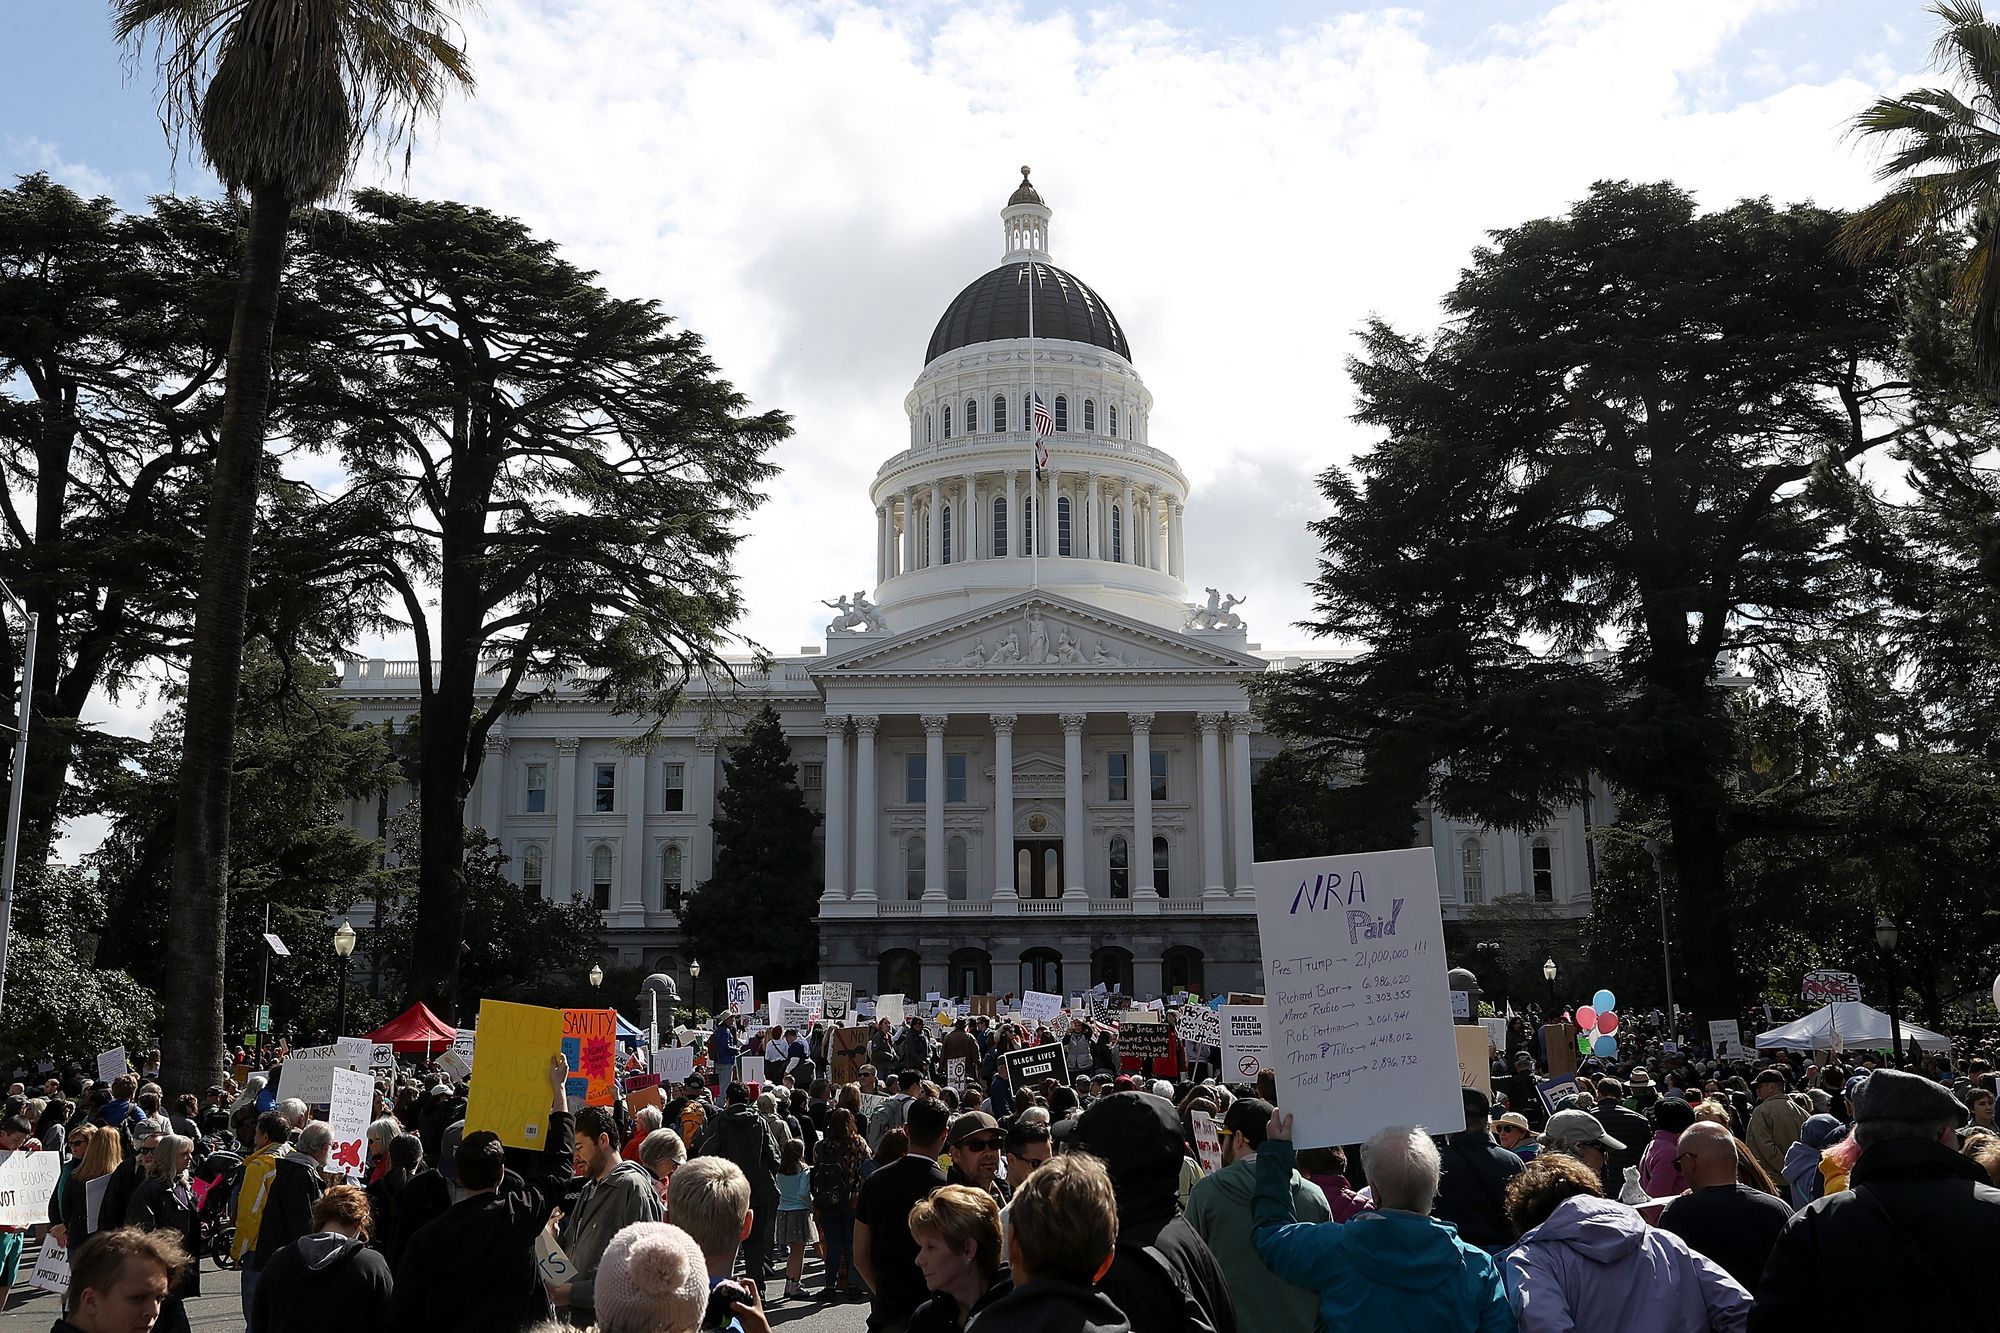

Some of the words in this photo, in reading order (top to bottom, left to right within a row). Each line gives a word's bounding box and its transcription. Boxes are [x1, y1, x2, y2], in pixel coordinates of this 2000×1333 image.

[1289, 870, 1366, 915] NRA
[1346, 899, 1405, 945] Paid
[1289, 957, 1333, 975] Trump
[1355, 949, 1409, 969] 21,000,000
[1276, 990, 1313, 1006] Richard
[1316, 983, 1341, 997] Burr
[562, 1012, 616, 1036] SANITY
[1184, 1006, 1202, 1019] Hey
[1202, 1011, 1220, 1027] Cong
[1279, 1009, 1308, 1025] Marco
[1309, 1002, 1339, 1016] Rubio
[1284, 1025, 1309, 1045] Rob
[1312, 1024, 1345, 1039] Portman
[313, 1045, 336, 1058] NRA
[1012, 1056, 1034, 1066] BLACK
[1037, 1051, 1056, 1060] LIVES
[1287, 1049, 1318, 1065] Thom
[654, 1055, 690, 1072] ENOUGH
[1024, 1064, 1050, 1075] MATTER
[1289, 1071, 1319, 1087] Todd
[1321, 1068, 1351, 1091] Young
[36, 1154, 48, 1168] TO
[21, 1171, 54, 1186] BOOKS
[20, 1188, 51, 1206] EULOG
